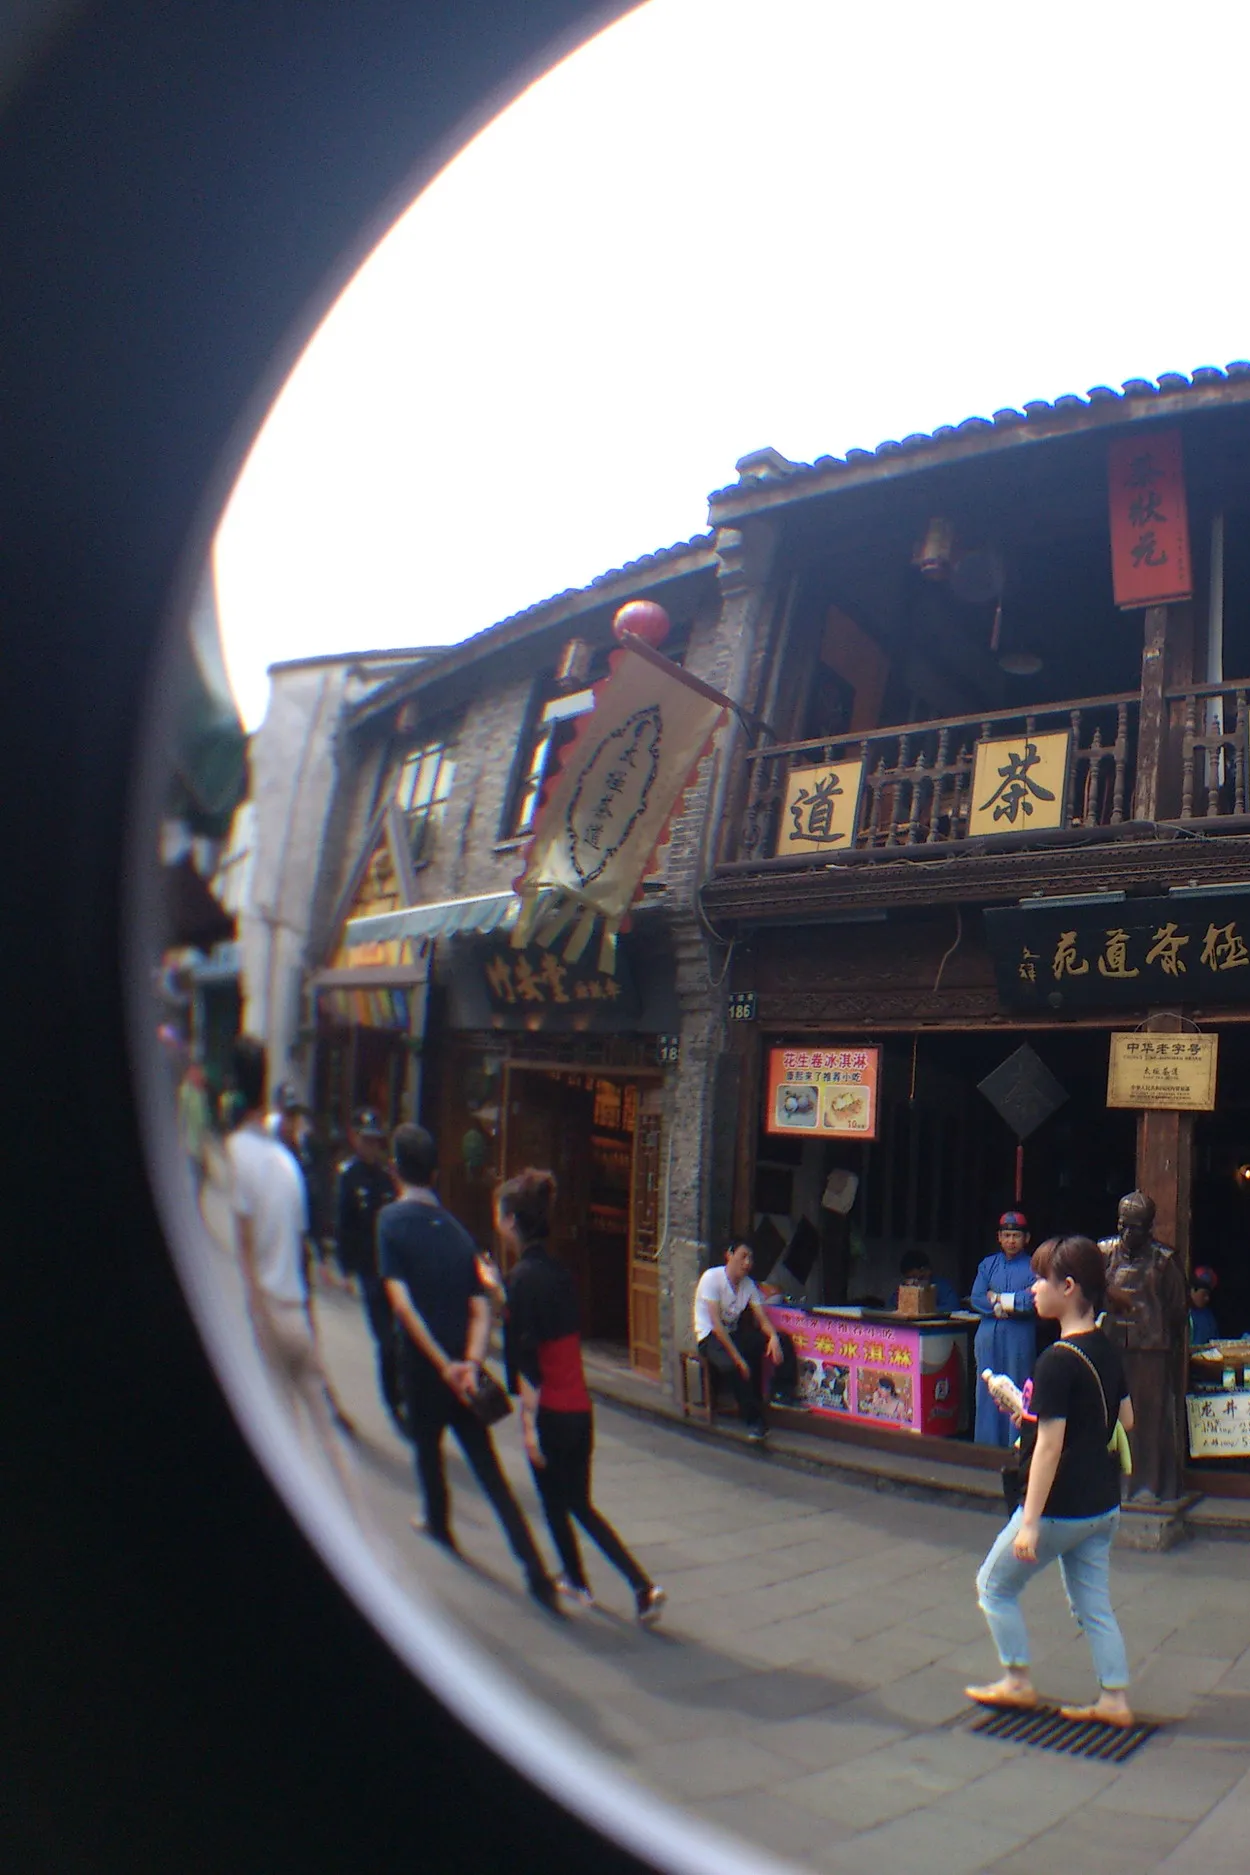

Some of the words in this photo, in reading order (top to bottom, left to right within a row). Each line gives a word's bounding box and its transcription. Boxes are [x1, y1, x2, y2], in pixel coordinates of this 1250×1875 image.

[979, 748, 1057, 825] 茶
[788, 772, 846, 843] 道
[729, 1004, 751, 1019] 186
[783, 1051, 868, 1069] 花生卷冰淇淋
[1126, 1042, 1201, 1055] 中华老字号
[792, 1334, 913, 1368] 生卷冰淇淋
